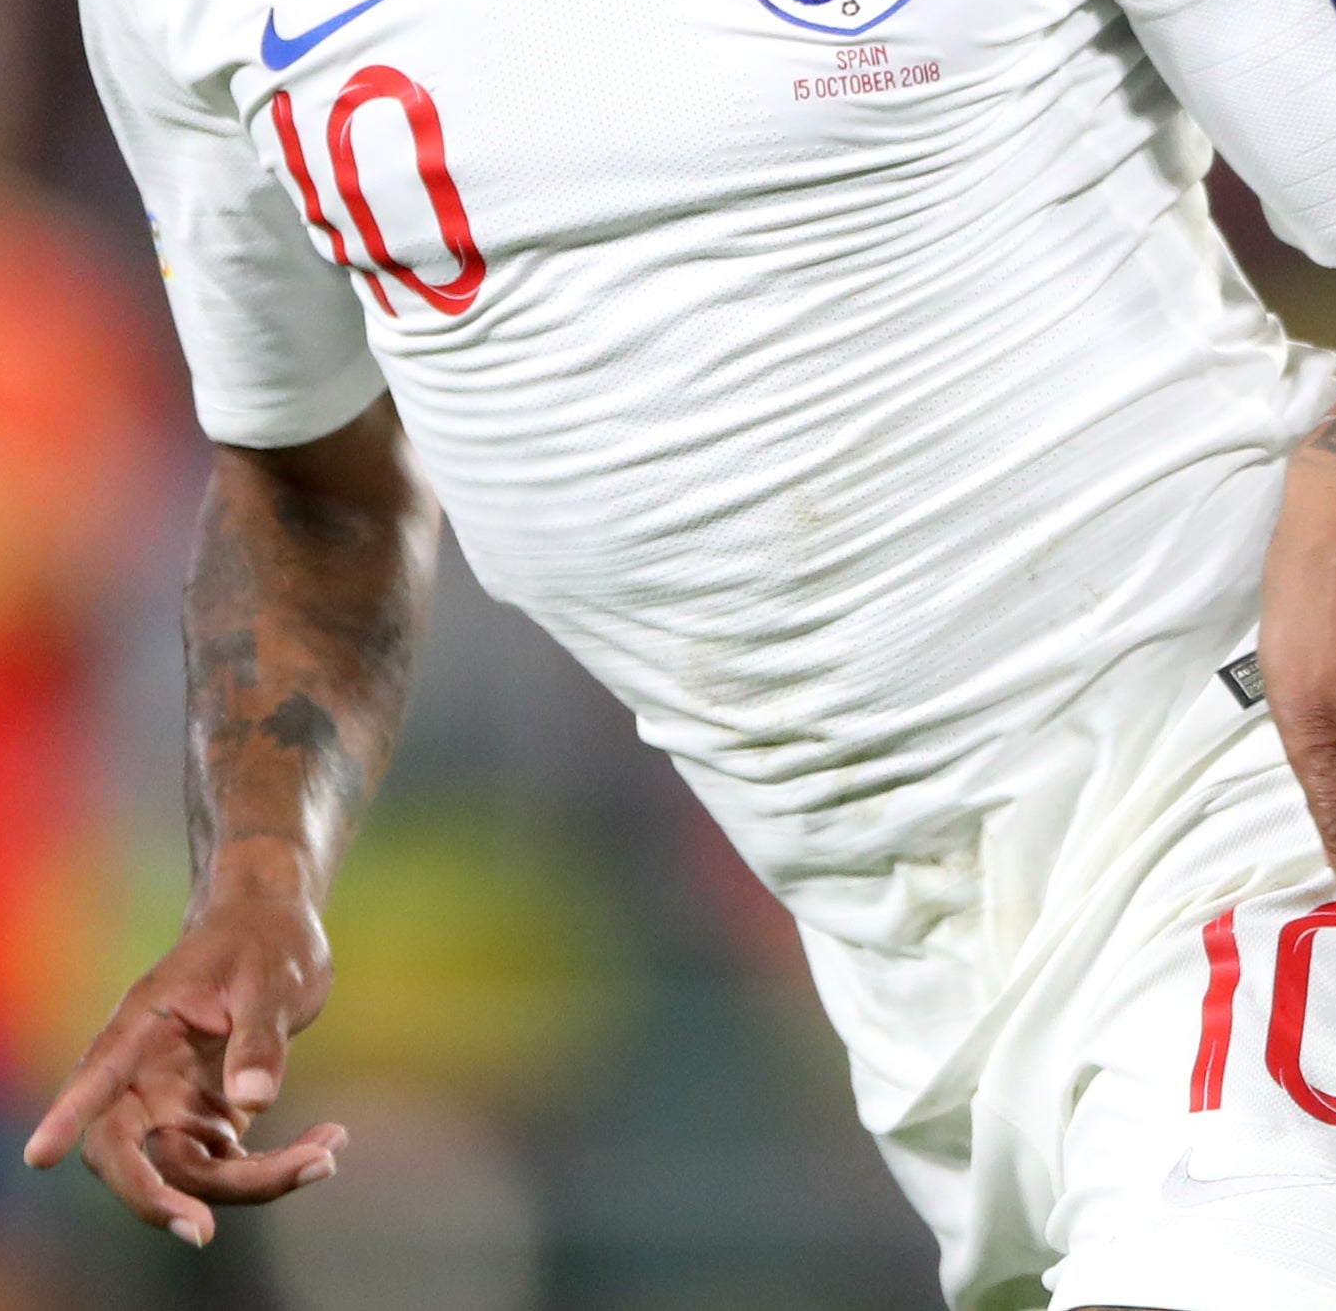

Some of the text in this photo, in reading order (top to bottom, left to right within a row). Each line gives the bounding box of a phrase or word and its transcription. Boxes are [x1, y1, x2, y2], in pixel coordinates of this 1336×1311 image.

[835, 44, 889, 70] SPAIN
[793, 61, 941, 101] 15 OCTOBER 2018
[270, 64, 487, 319] 10
